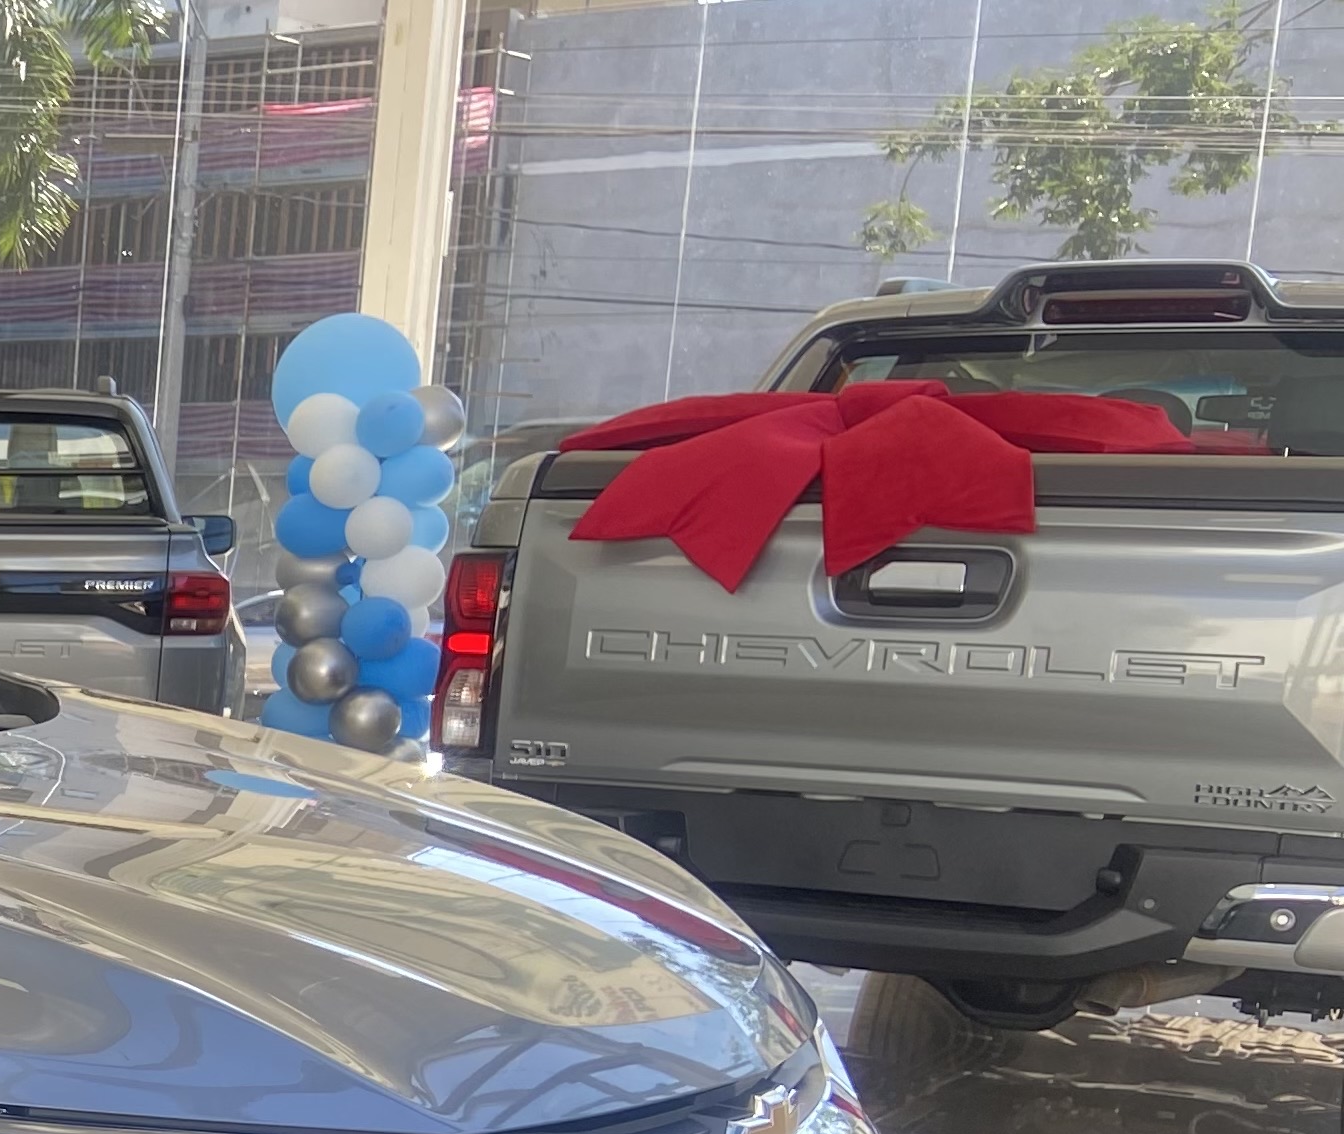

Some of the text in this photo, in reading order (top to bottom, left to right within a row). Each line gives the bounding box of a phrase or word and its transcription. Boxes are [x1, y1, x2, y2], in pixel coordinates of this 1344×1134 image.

[83, 579, 154, 591] PREMIER
[585, 628, 1266, 689] CHEVROLET
[510, 739, 570, 759] S10
[1195, 784, 1264, 798] HIGH
[1194, 795, 1334, 814] COUNTRY
